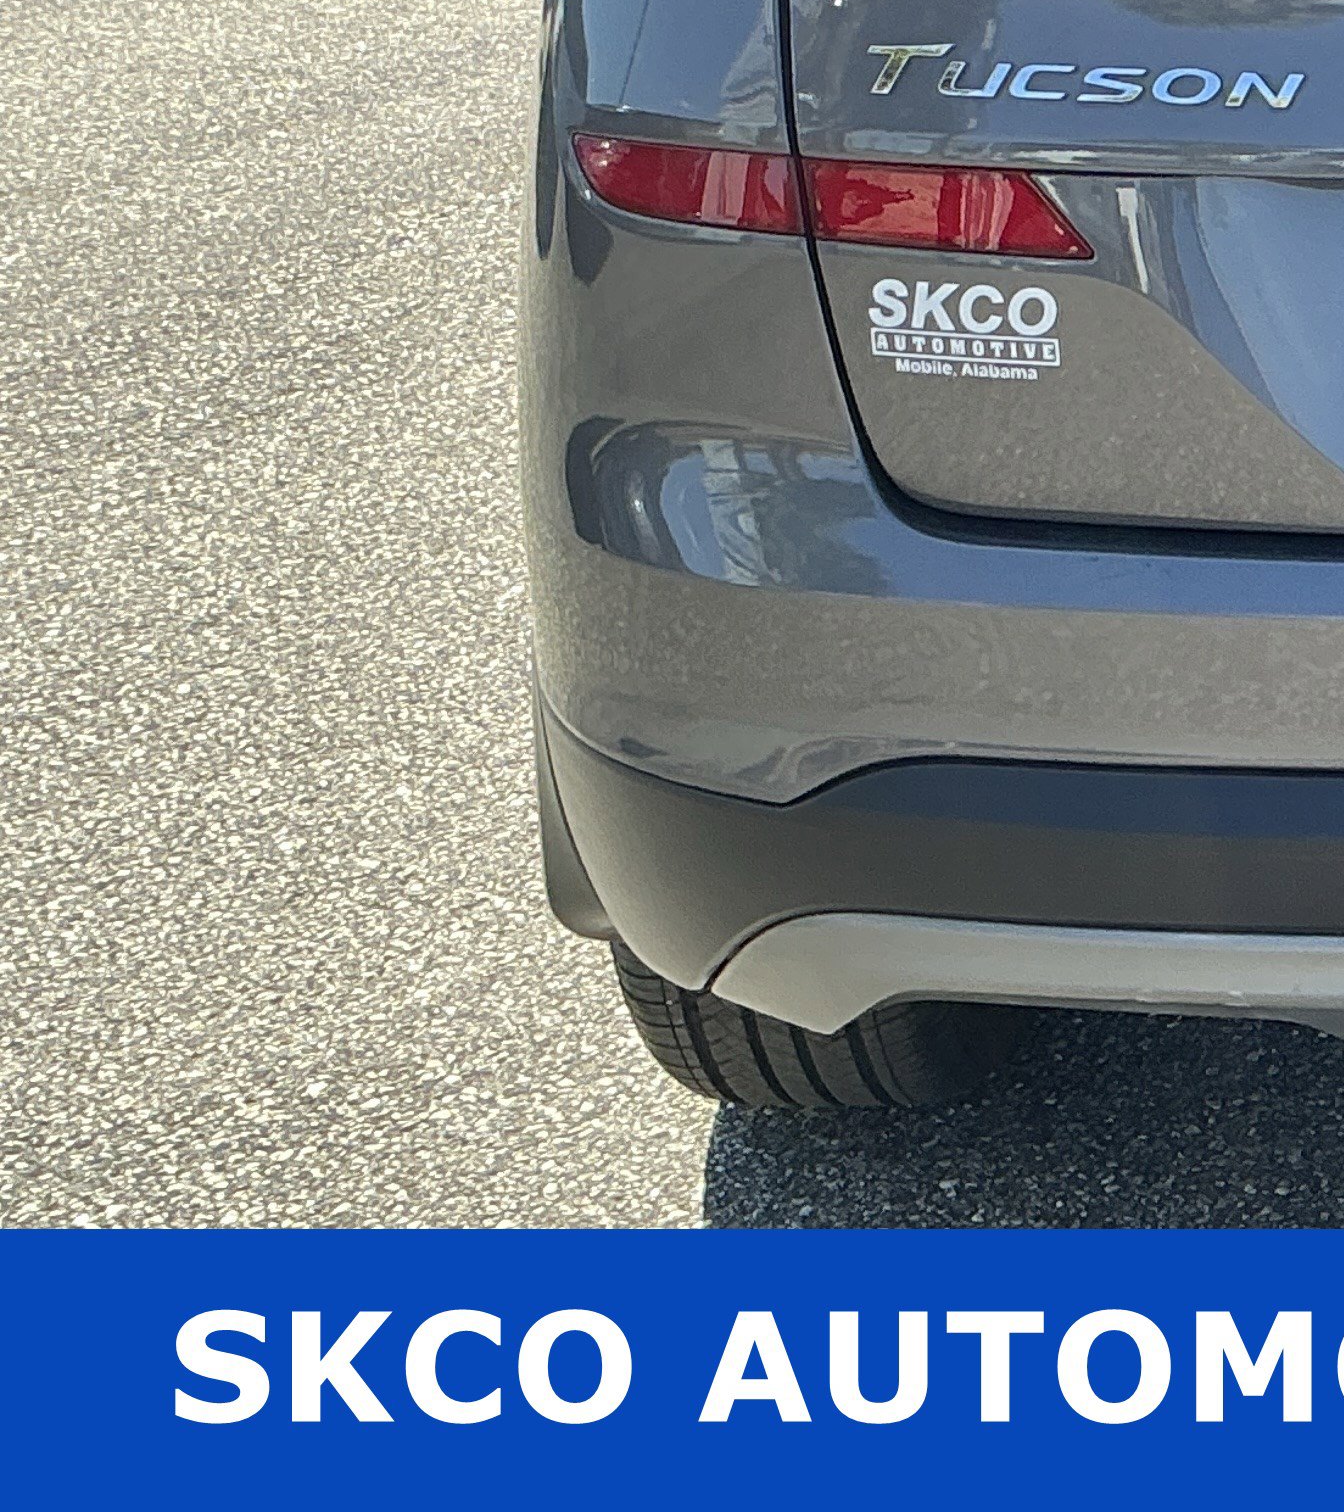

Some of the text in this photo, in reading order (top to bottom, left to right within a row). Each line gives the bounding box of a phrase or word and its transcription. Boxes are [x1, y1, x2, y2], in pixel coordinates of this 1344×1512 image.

[866, 42, 1306, 108] TUCSON
[868, 278, 1059, 336] SKCO
[876, 333, 1057, 361] AUTOMOTIVE
[895, 357, 1039, 381] Mobile, Alabama
